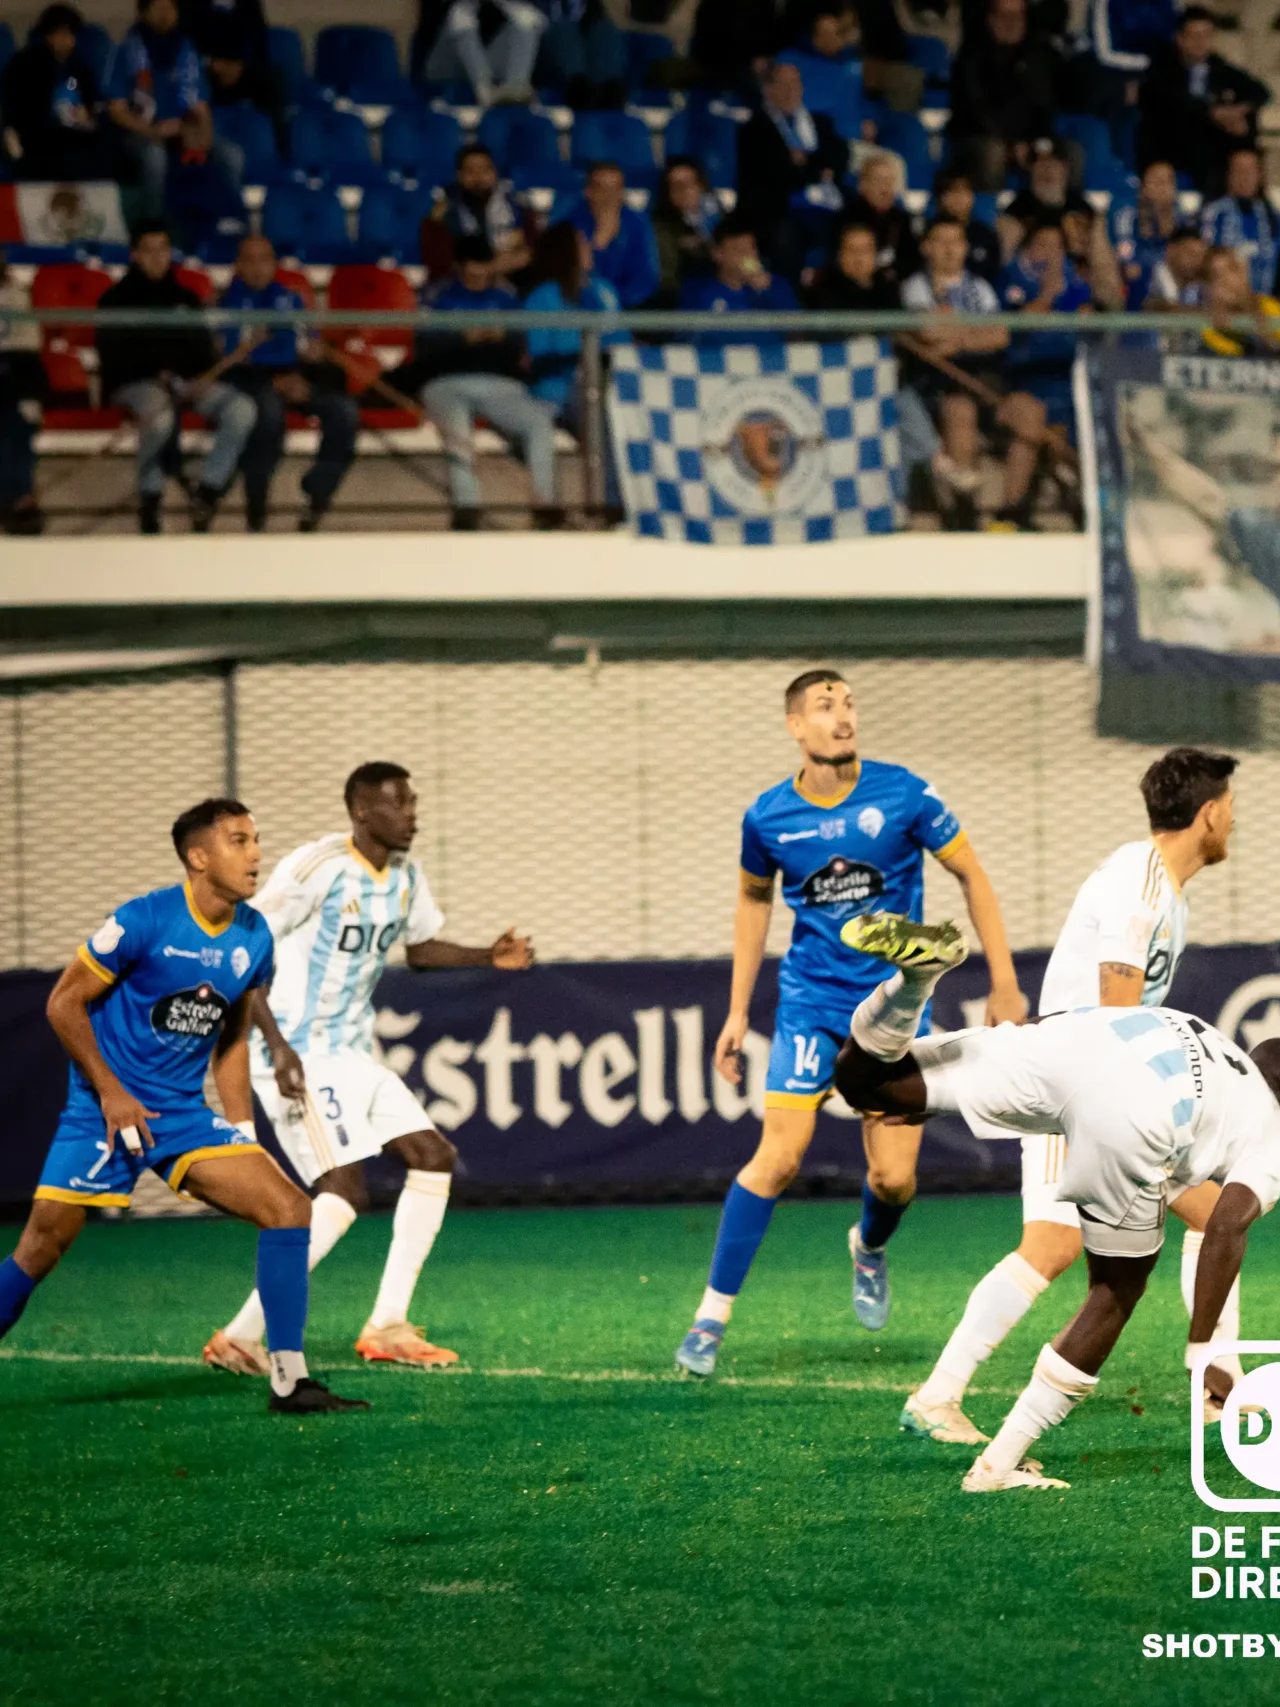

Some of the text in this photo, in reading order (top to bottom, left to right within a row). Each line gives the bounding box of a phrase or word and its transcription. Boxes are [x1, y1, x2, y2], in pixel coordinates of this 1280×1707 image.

[793, 1034, 820, 1077] 14
[318, 1086, 342, 1120] 3
[86, 1139, 113, 1180] 7
